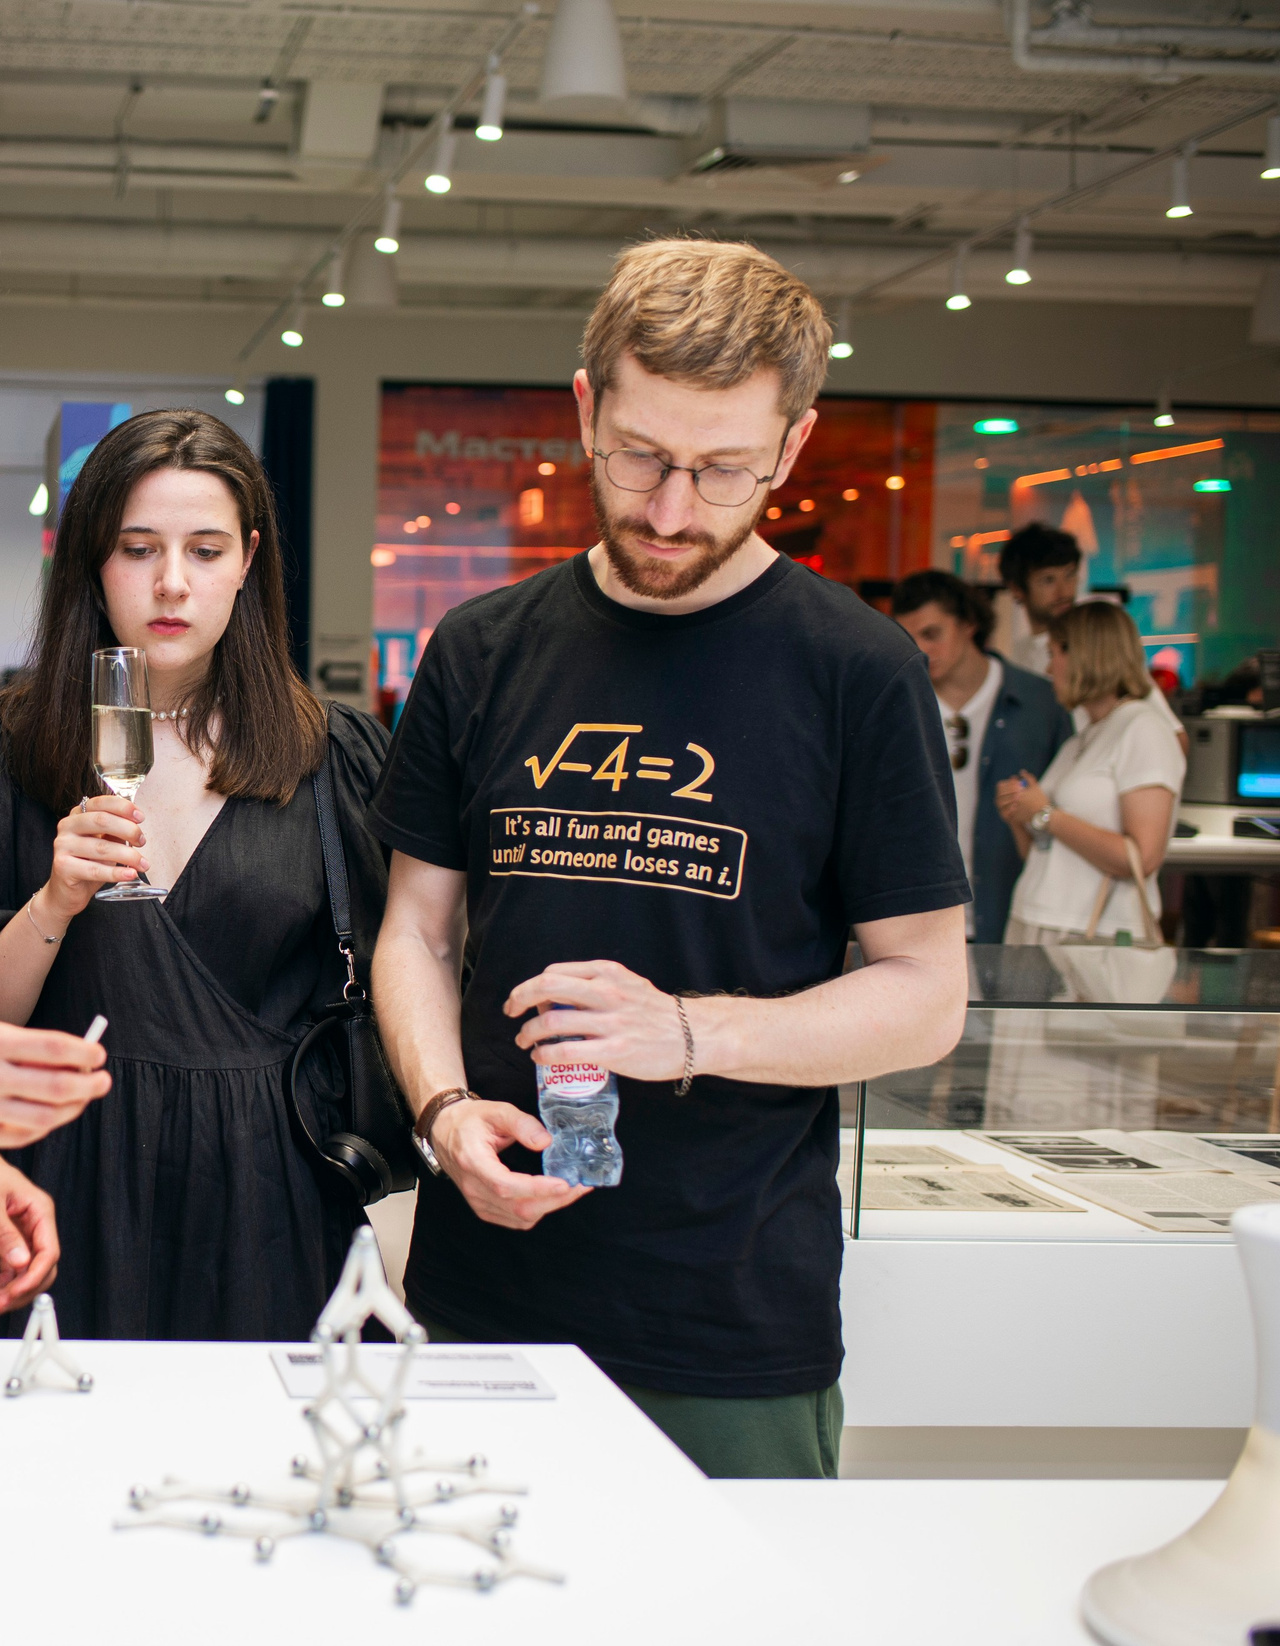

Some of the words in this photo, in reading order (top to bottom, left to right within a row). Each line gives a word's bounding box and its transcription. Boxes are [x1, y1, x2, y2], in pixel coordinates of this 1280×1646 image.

[415, 431, 586, 468] Мастер
[505, 815, 531, 836] It's
[534, 816, 561, 837] all
[567, 818, 599, 840] fun
[603, 820, 641, 842] and
[646, 827, 720, 854] games
[492, 843, 526, 864] until
[530, 848, 618, 869] someone
[624, 849, 680, 876] loses
[685, 862, 713, 882] an
[545, 1072, 607, 1086] ИСТОЧНИК
